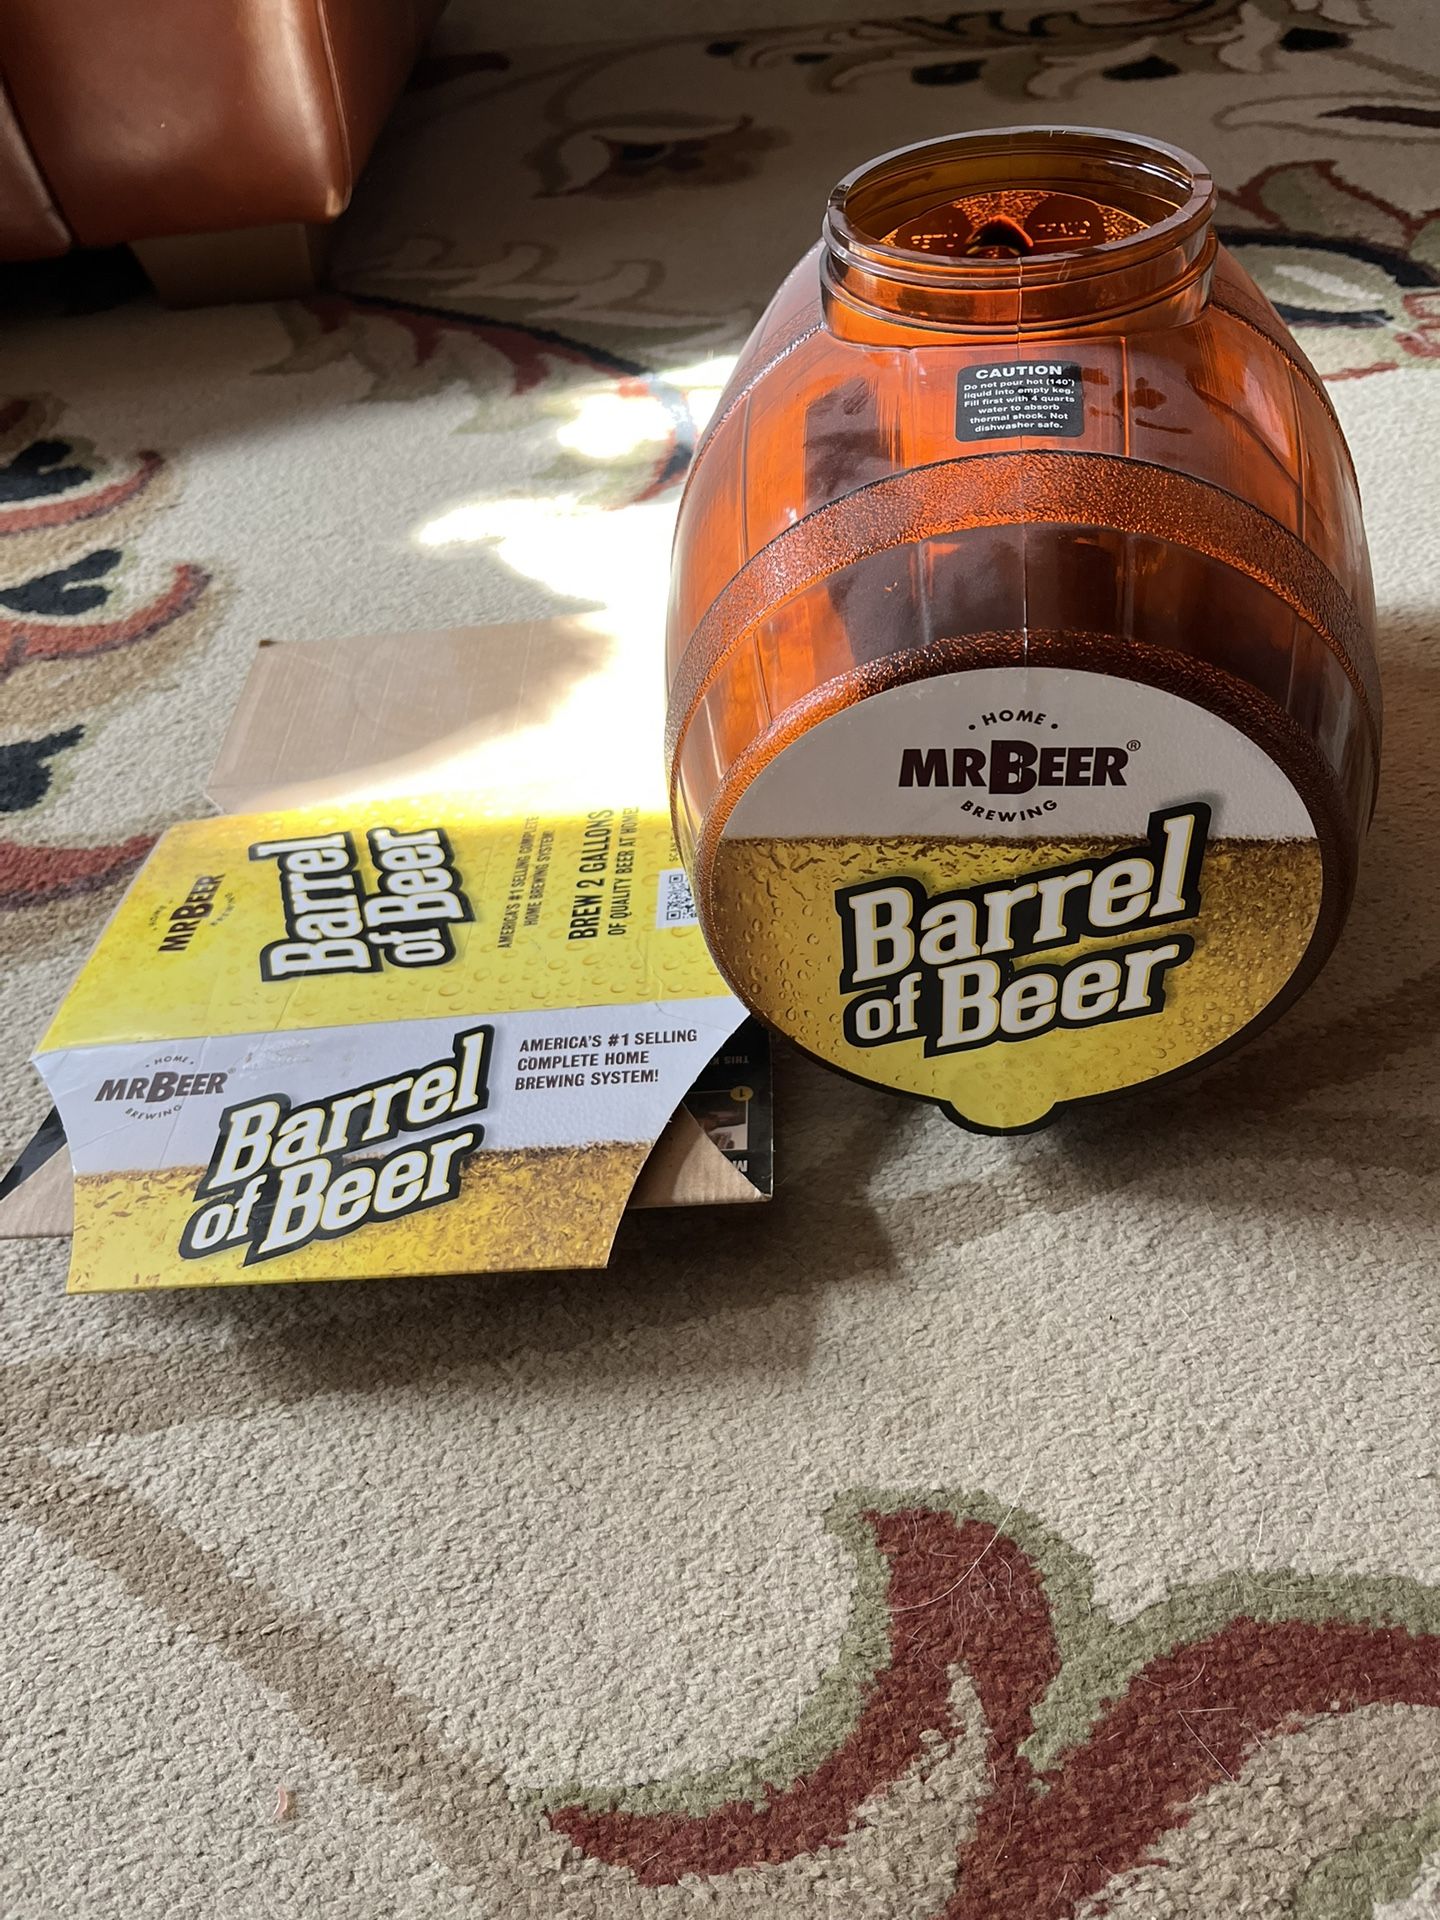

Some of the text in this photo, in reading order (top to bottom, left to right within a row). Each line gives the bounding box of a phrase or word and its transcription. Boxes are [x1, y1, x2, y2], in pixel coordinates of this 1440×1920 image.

[975, 365, 1063, 379] CAUTION
[963, 386, 1074, 399] liquid into empty keg.
[980, 381, 997, 389] not
[1000, 380, 1023, 388] pour
[963, 400, 980, 408] Fill
[982, 397, 1003, 406] first
[1006, 395, 1028, 403] with
[1040, 394, 1075, 403] quarts
[977, 406, 1008, 414] water
[1023, 403, 1060, 411] absorb
[969, 412, 1068, 424] thermal shock. Not
[974, 421, 1063, 433] dishwasher safe.
[982, 709, 1047, 726] HOME
[960, 799, 1058, 822] BREWING
[619, 837, 636, 849] AT
[615, 849, 636, 875] BEER
[528, 863, 549, 899] BREWING
[568, 809, 614, 940] BREW 2 GALLONS
[254, 832, 374, 977] Barrel
[361, 828, 465, 964] of Beer
[497, 903, 521, 948] AMERICA'S
[511, 855, 531, 888] SELLING
[610, 877, 632, 919] QUALITY
[846, 812, 1198, 985] Barrel
[523, 901, 542, 926] HOME
[608, 923, 627, 936] OF
[853, 942, 1183, 1049] of Beer
[519, 1029, 697, 1052] AMERICA'S #1 SELLING
[154, 1054, 189, 1065] HOME
[517, 1050, 650, 1071] COMPLETE HOME
[515, 1069, 659, 1091] BREWING SYSTEM!
[125, 1103, 183, 1121] BREWING
[205, 1029, 487, 1193] Barrel
[187, 1130, 476, 1256] of Beer
